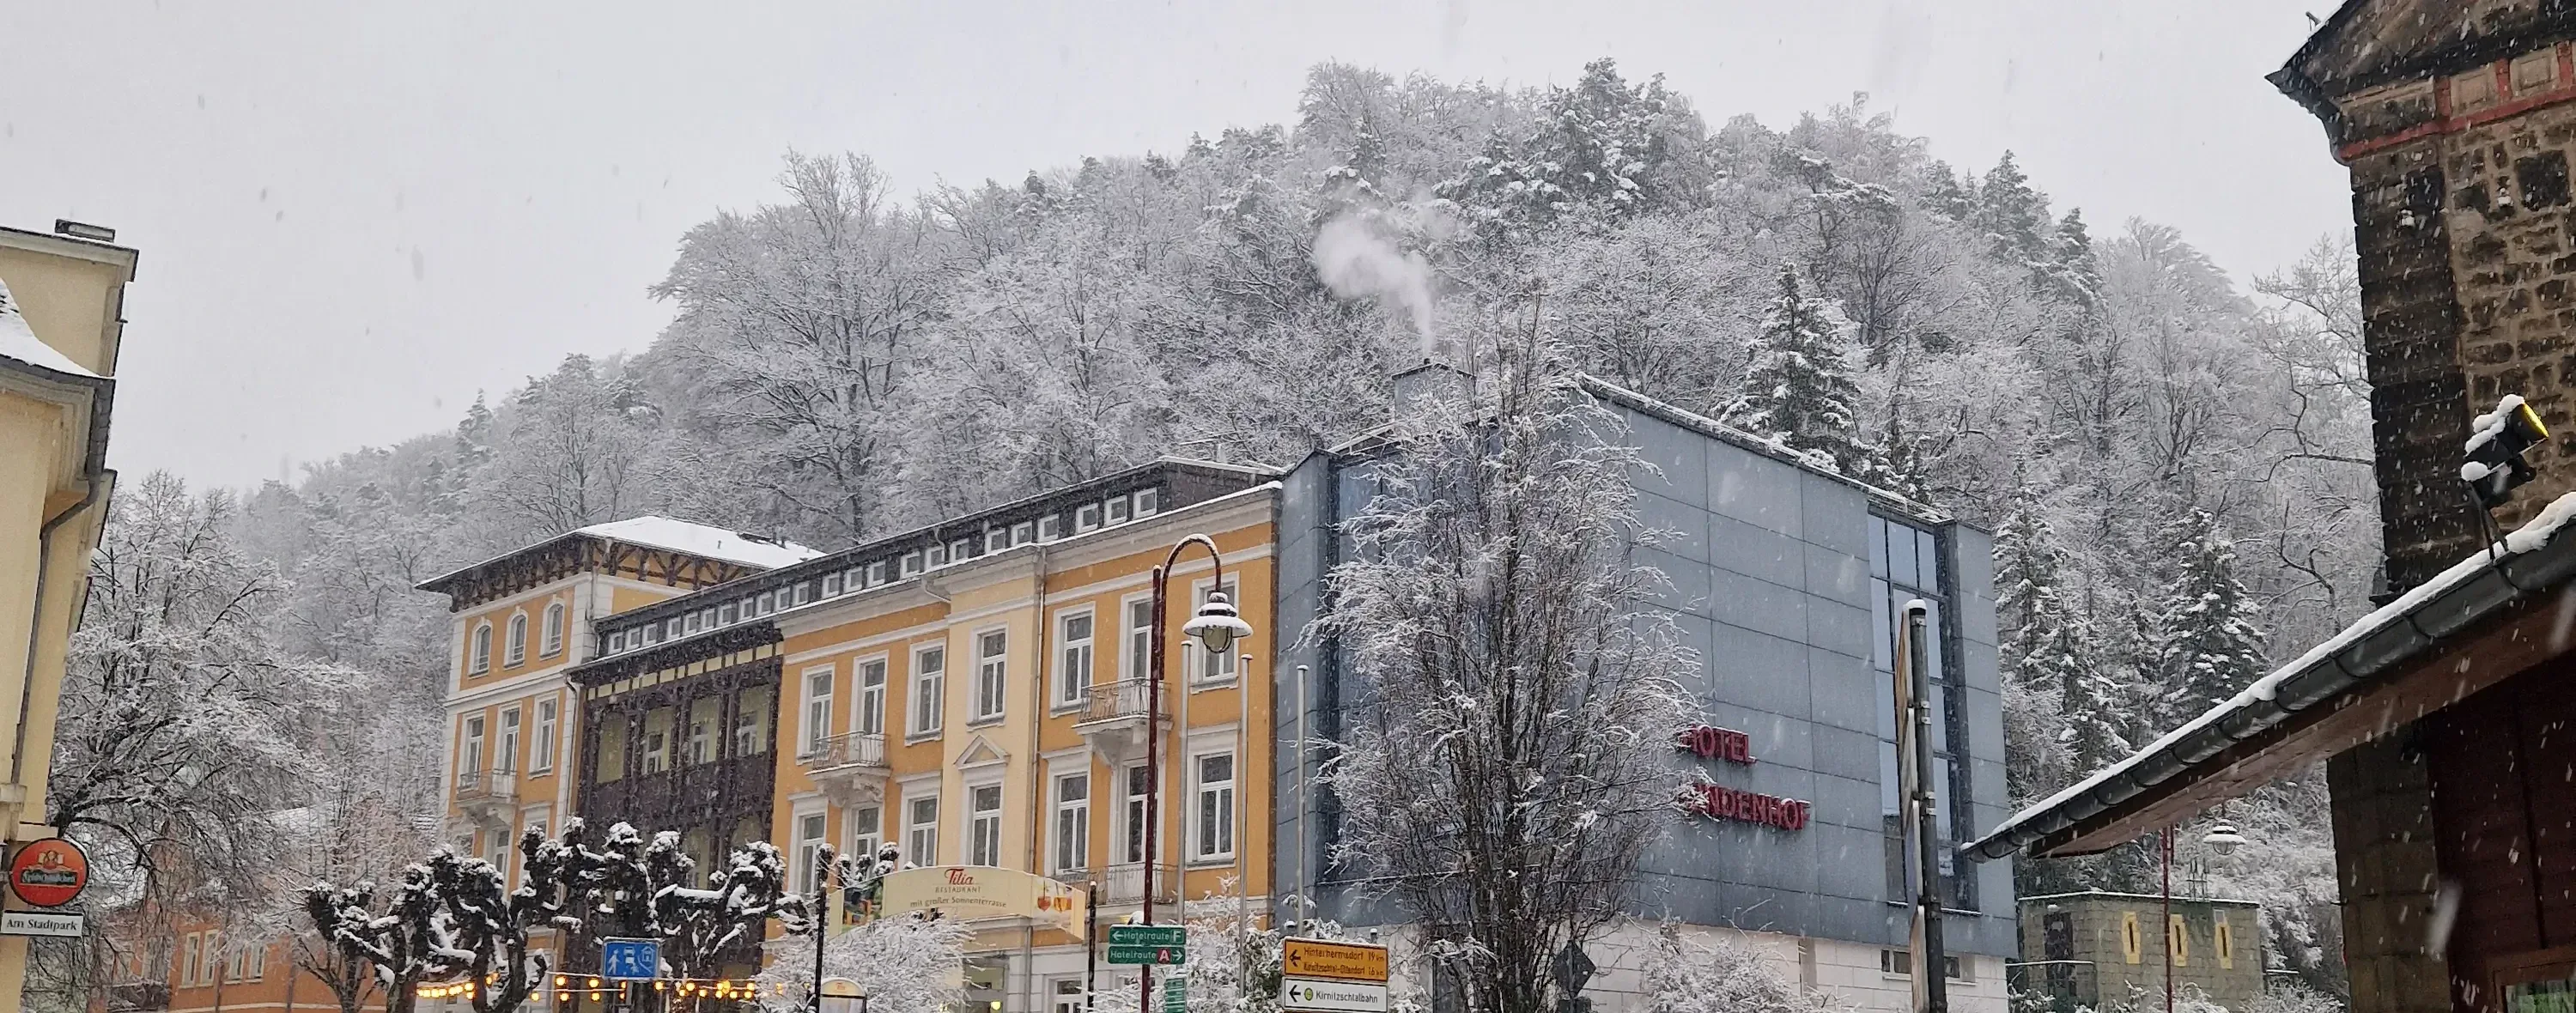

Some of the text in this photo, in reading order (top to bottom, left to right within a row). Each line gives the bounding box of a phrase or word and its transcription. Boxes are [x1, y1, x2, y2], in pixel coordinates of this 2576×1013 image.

[945, 868, 974, 885] Tilia
[925, 897, 949, 907] großer
[951, 897, 1006, 907] Sonnenterrasse
[7, 919, 77, 931] Am Stadtpark
[1124, 930, 1182, 942] Hotelroute F
[1110, 949, 1170, 961] Hotelroute A
[1315, 990, 1378, 1004] Kirnitzschtalbahn
